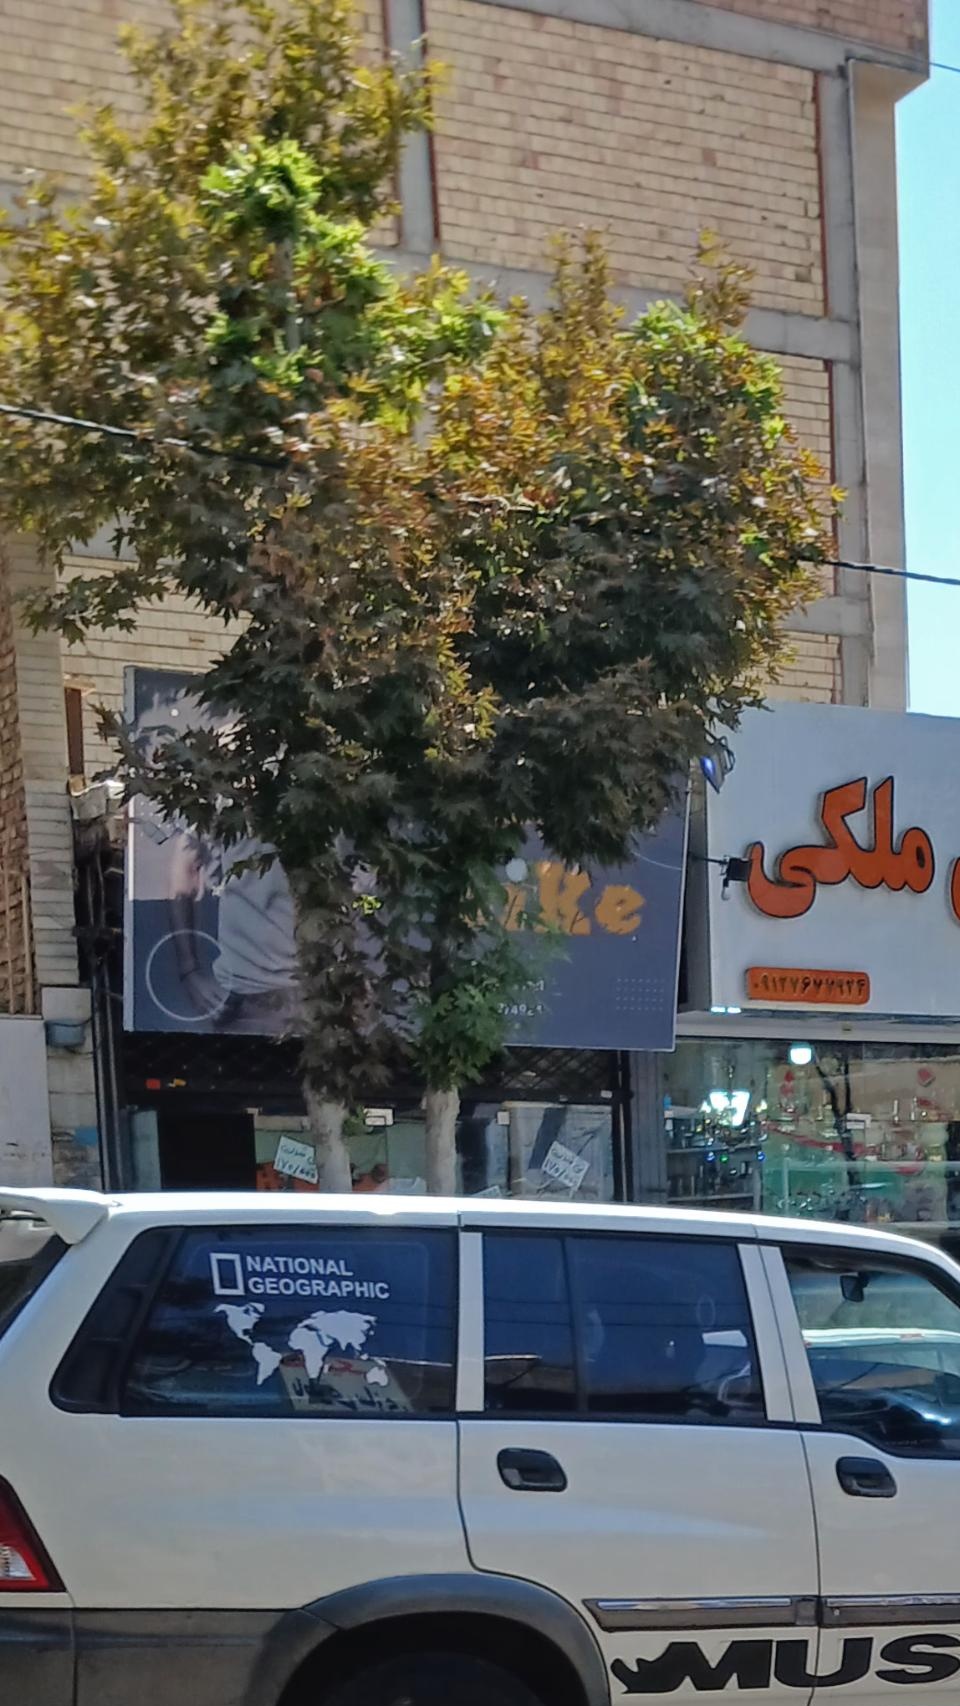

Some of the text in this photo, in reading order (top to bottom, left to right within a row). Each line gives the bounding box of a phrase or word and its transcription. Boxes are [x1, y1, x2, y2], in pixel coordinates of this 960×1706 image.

[746, 775, 935, 918] ملکی
[246, 1255, 354, 1277] NATIONAL
[248, 1277, 390, 1299] GEOGRAPHIC
